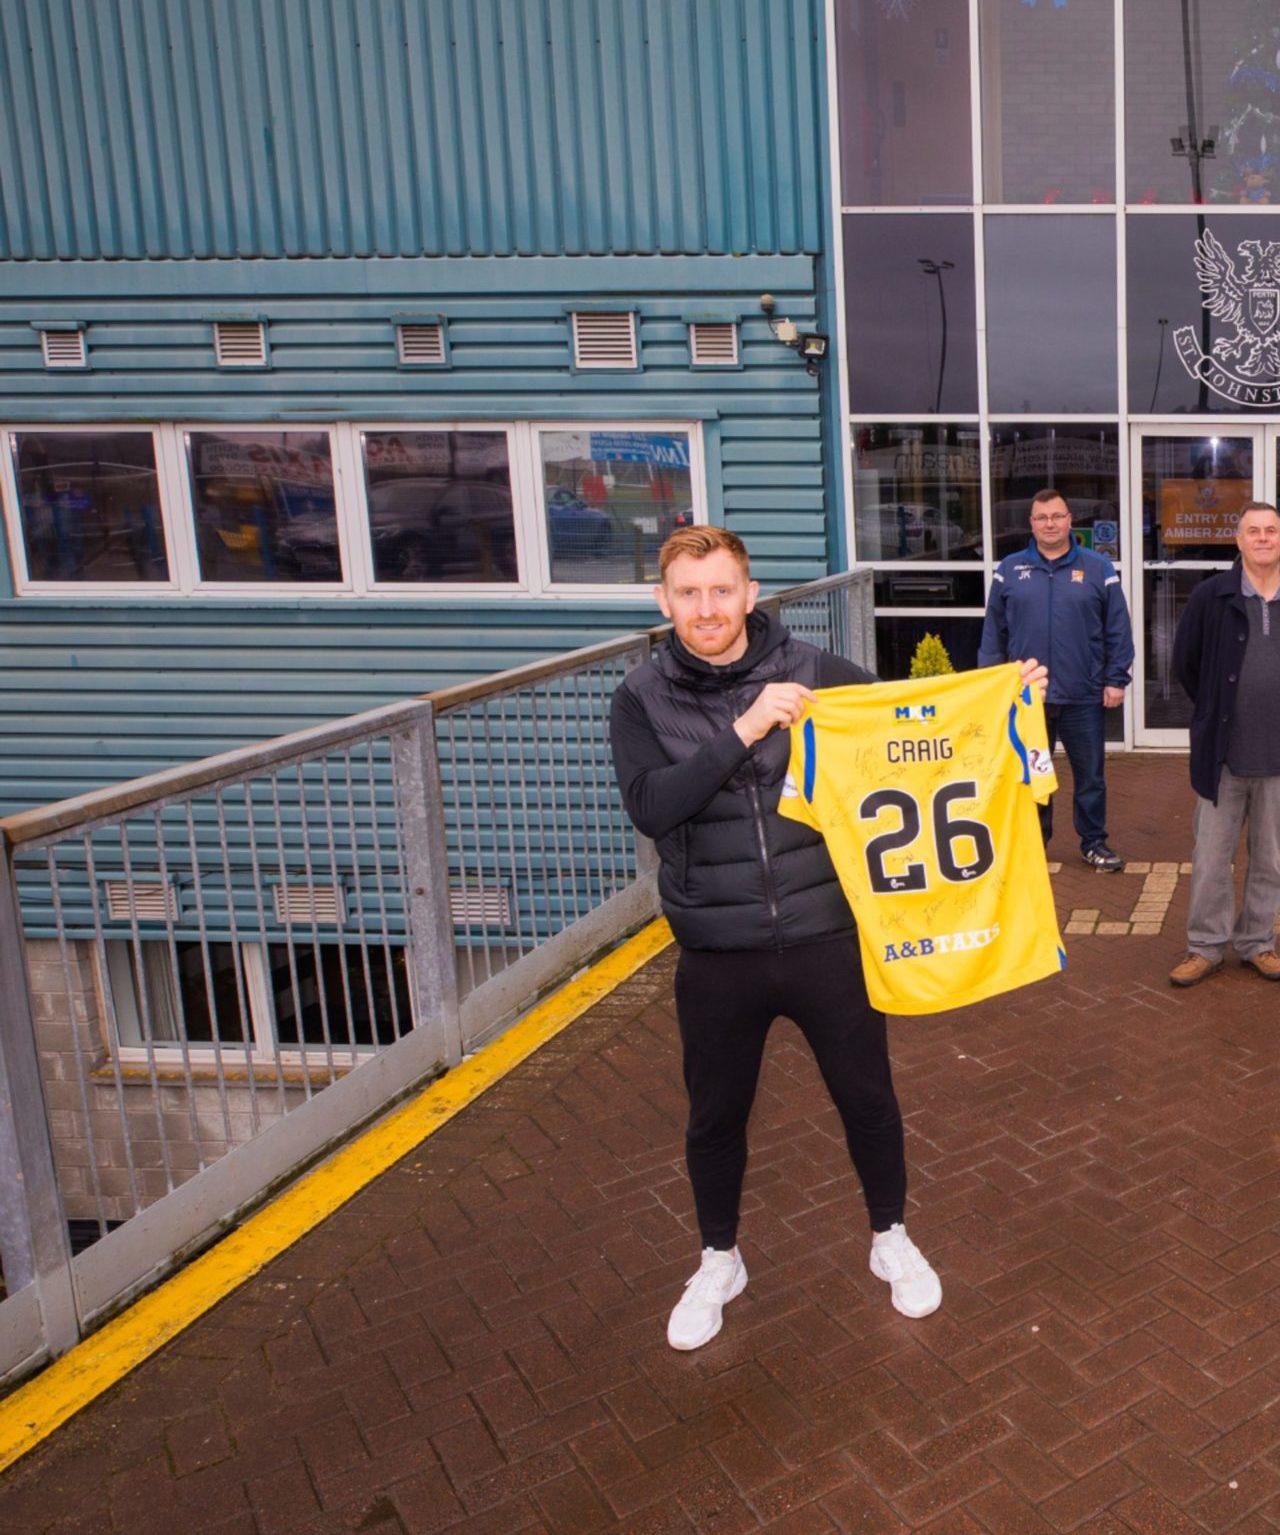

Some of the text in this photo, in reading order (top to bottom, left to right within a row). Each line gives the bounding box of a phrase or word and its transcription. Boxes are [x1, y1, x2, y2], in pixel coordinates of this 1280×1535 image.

[1175, 513, 1240, 524] ENTRY TO
[1164, 527, 1239, 538] AMBER ZON
[1018, 570, 1031, 581] JK
[887, 737, 953, 764] CRAIG
[861, 781, 993, 892] 26
